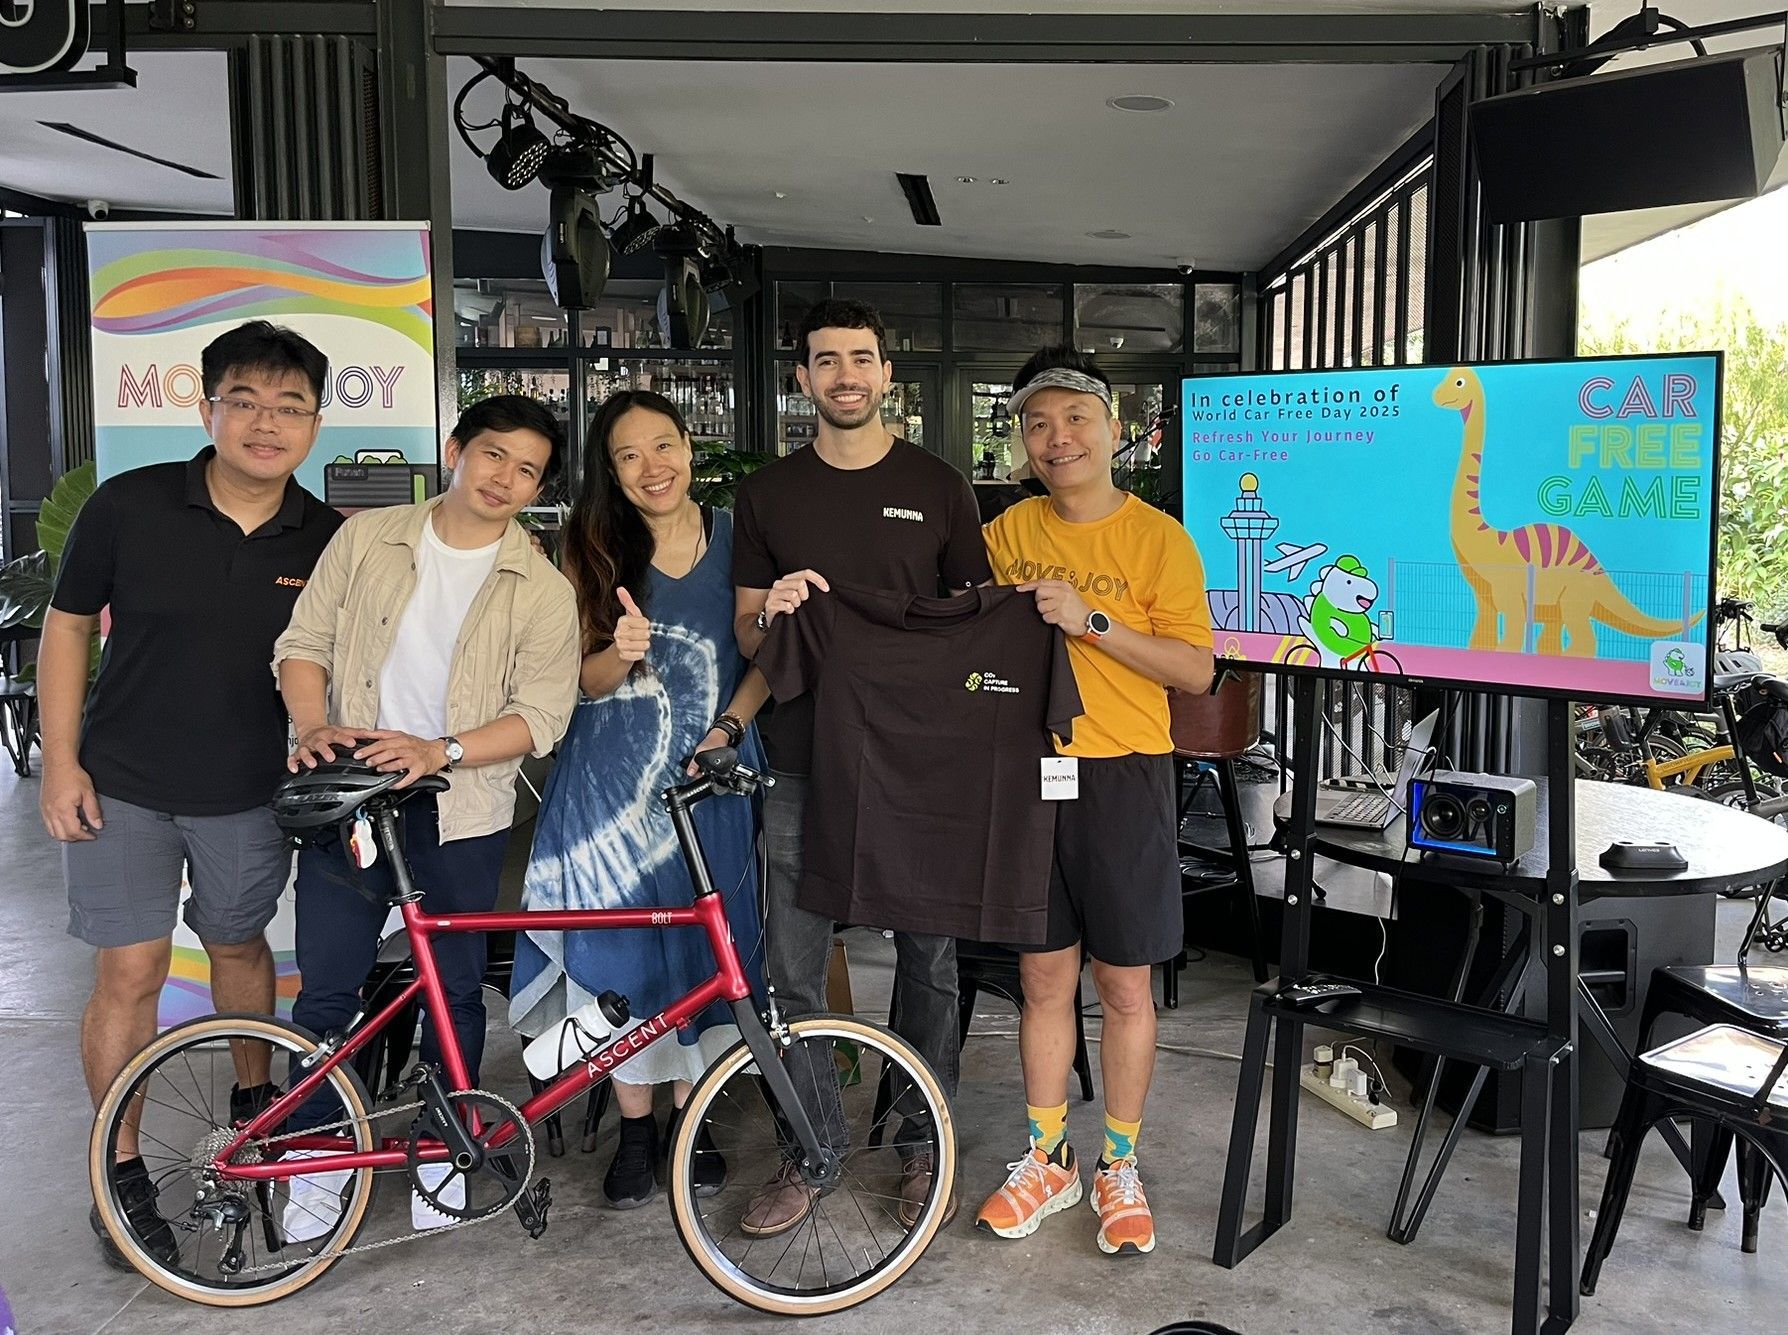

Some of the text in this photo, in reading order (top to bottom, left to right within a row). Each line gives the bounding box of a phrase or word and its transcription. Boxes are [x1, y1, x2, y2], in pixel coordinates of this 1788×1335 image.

[1191, 384, 1400, 407] In celebration of
[1578, 373, 1698, 419] CAR
[1192, 406, 1399, 421] World Car Free Day 2025
[1192, 430, 1375, 444] Refresh Your Journey
[1568, 424, 1703, 469] FREE
[1192, 449, 1288, 461] Go Car-Free
[1537, 475, 1701, 520] GAME
[883, 507, 924, 522] KEMUNNA
[651, 912, 673, 925] BOLT
[588, 1012, 667, 1078] ASCENT
